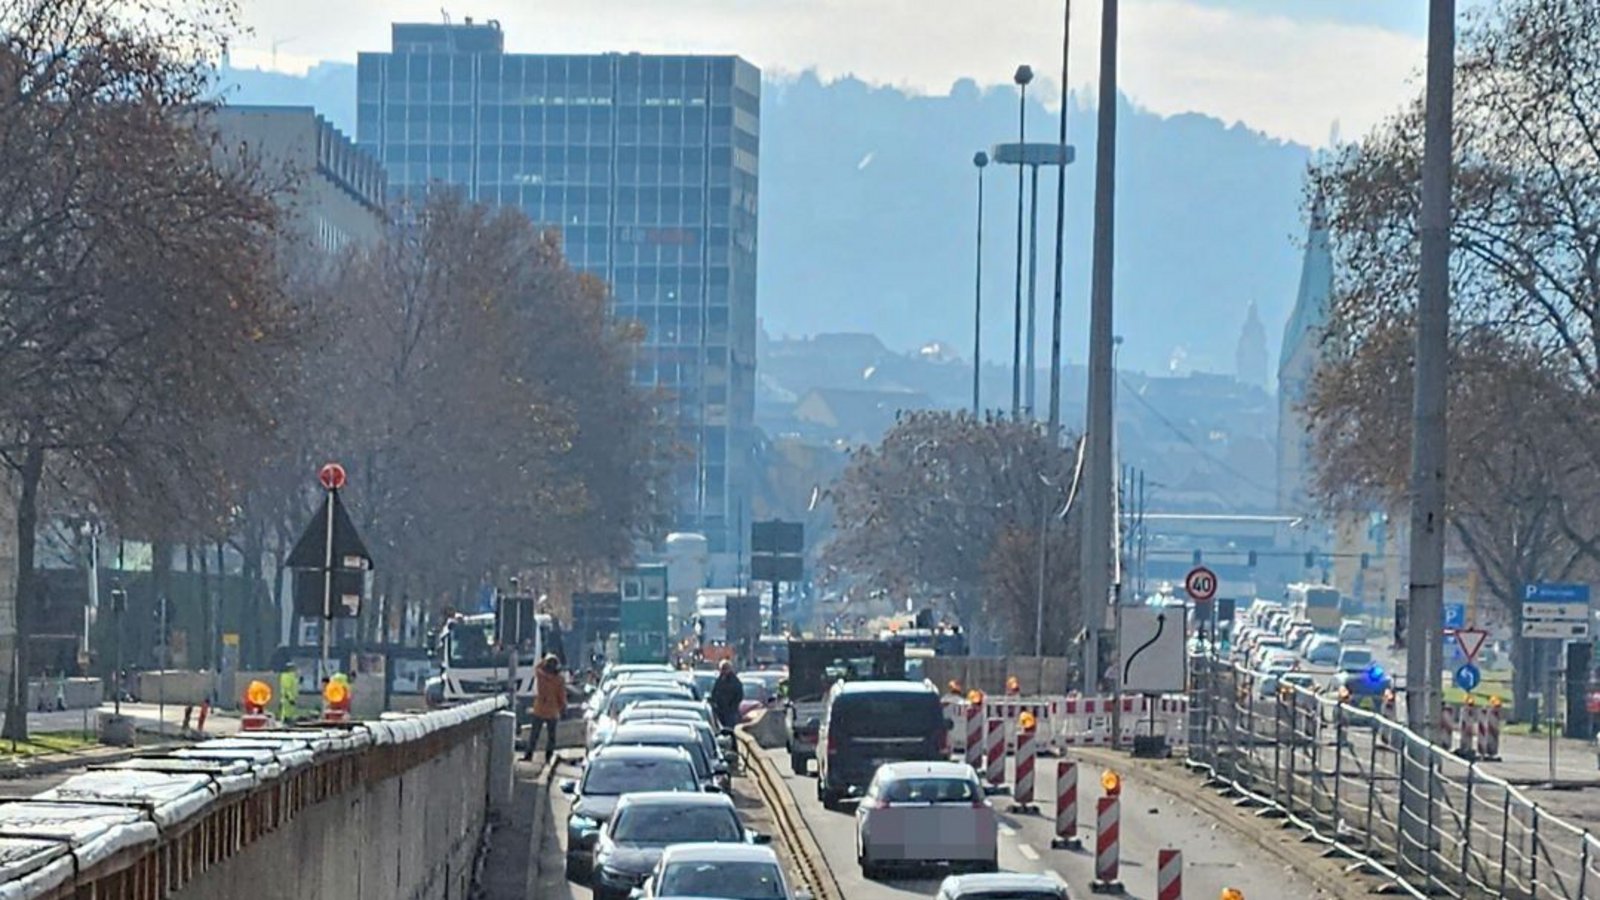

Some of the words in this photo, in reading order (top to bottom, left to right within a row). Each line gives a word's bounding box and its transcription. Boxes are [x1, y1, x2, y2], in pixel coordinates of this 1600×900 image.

[1193, 576, 1211, 592] 40
[1526, 585, 1537, 599] P
[1445, 610, 1457, 624] P
